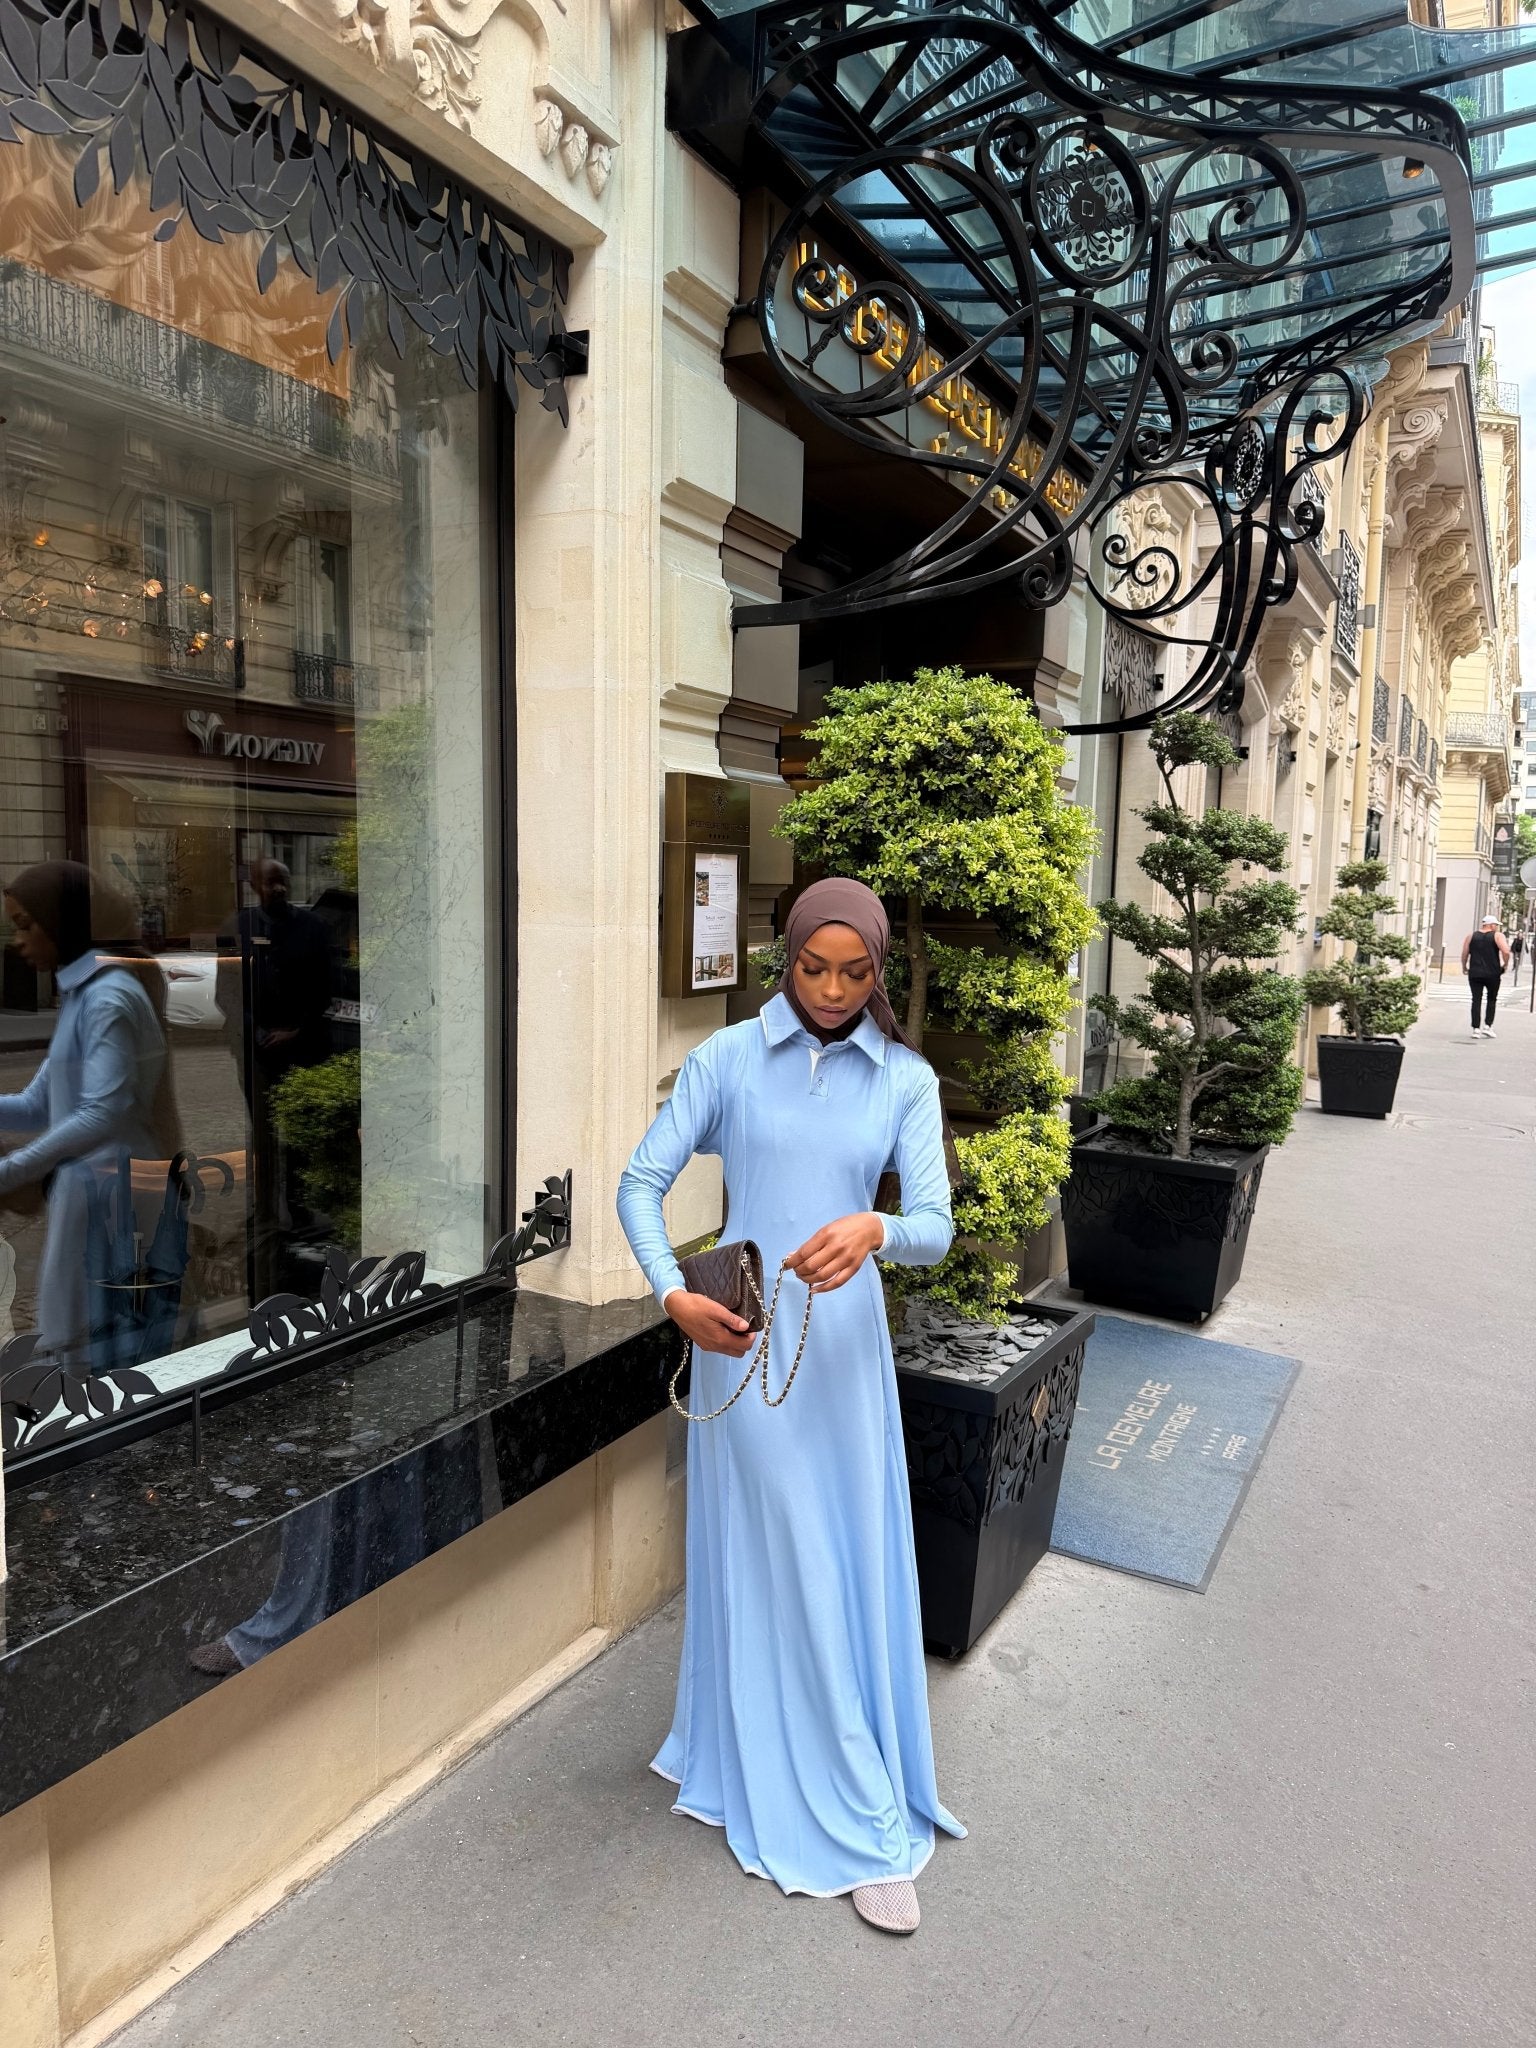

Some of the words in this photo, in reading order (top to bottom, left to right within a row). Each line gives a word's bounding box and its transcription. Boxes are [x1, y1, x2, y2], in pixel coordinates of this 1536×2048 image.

[858, 296, 992, 440] DEEURE
[1105, 1379, 1173, 1446] DEMEURE
[1145, 1402, 1198, 1463] MONTAIGNE
[1087, 1443, 1128, 1471] LA
[1221, 1433, 1248, 1461] PARIS
